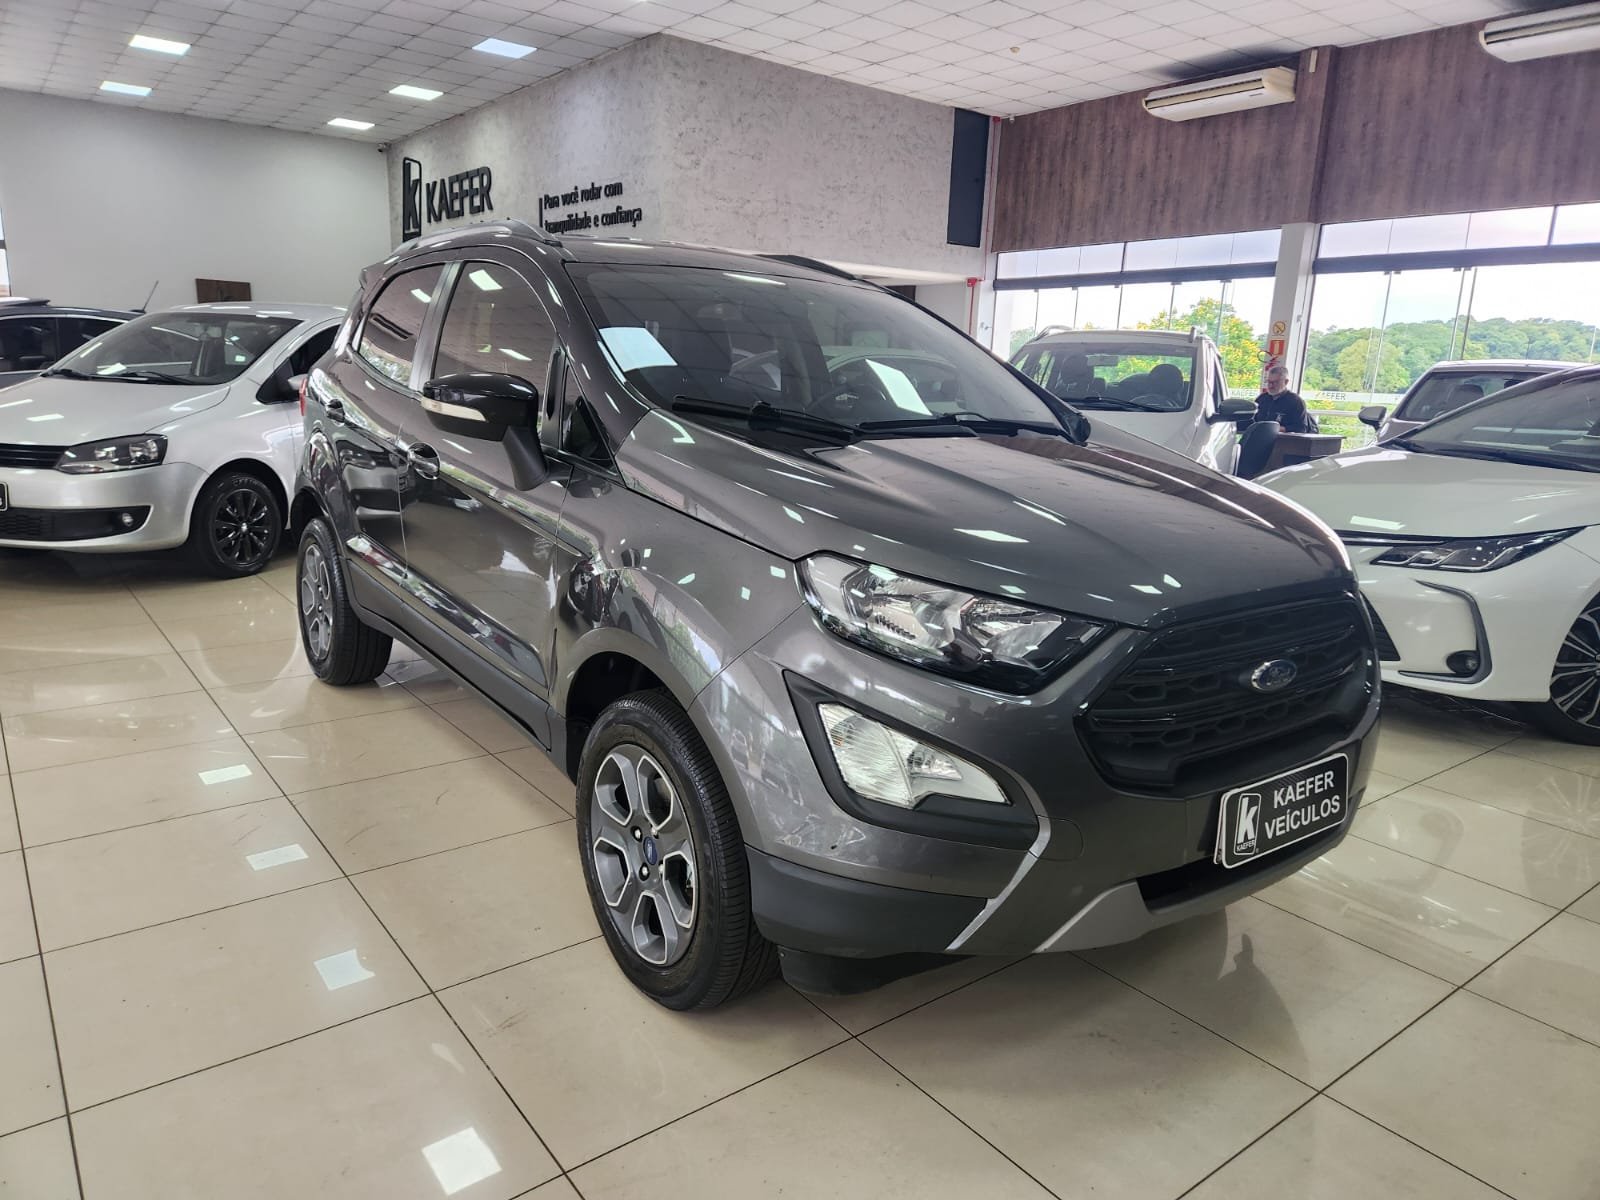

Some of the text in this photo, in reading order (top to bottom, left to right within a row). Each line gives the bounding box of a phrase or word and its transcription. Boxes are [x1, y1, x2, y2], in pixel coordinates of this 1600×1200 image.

[425, 166, 494, 223] KAEFER
[543, 182, 623, 209] Para você rodar com
[593, 214, 600, 227] e
[600, 205, 643, 227] confiança
[1273, 771, 1334, 808] KAEFER
[1265, 795, 1341, 839] VEÍCULOS
